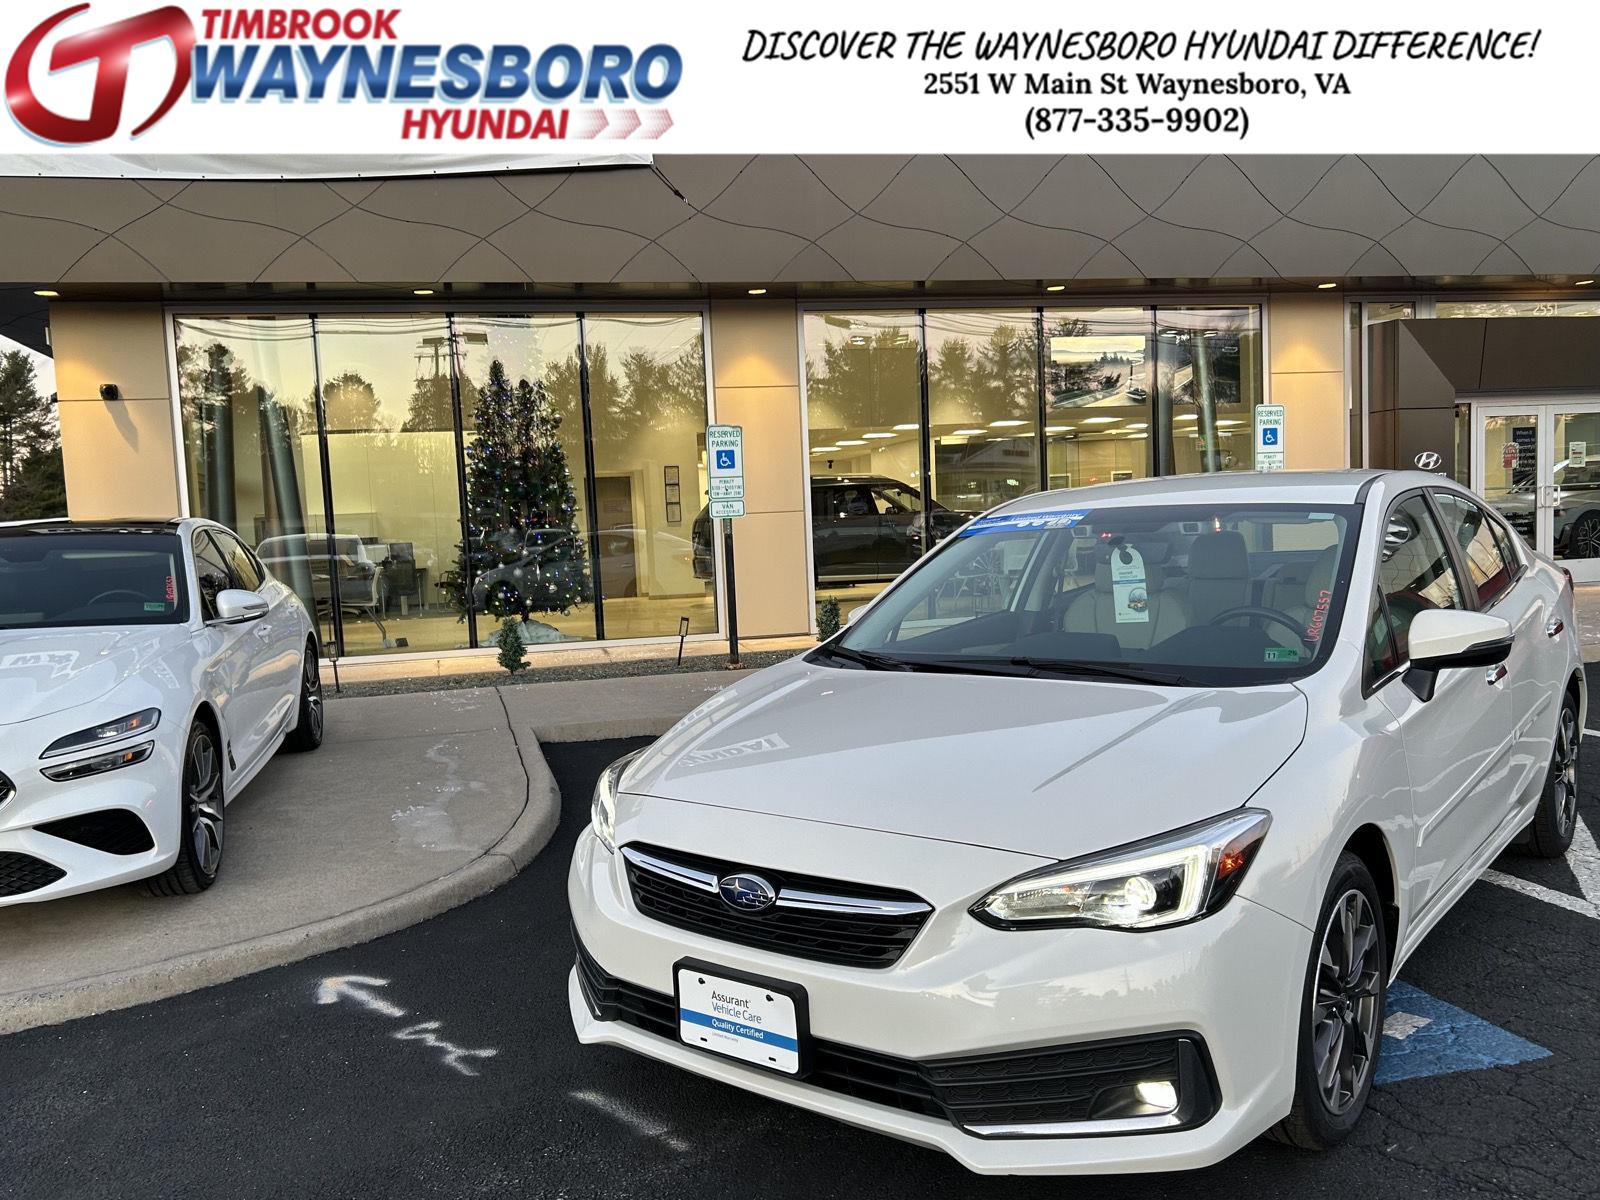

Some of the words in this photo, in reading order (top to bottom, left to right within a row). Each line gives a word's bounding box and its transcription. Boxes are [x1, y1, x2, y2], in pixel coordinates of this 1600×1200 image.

[1533, 303, 1558, 315] 2551
[709, 430, 740, 438] RESERVED
[711, 990, 750, 1009] Assurant
[711, 1002, 742, 1018] Vehicle
[742, 1010, 762, 1024] Care
[711, 1019, 735, 1032] Quality
[735, 1025, 764, 1039] Certified
